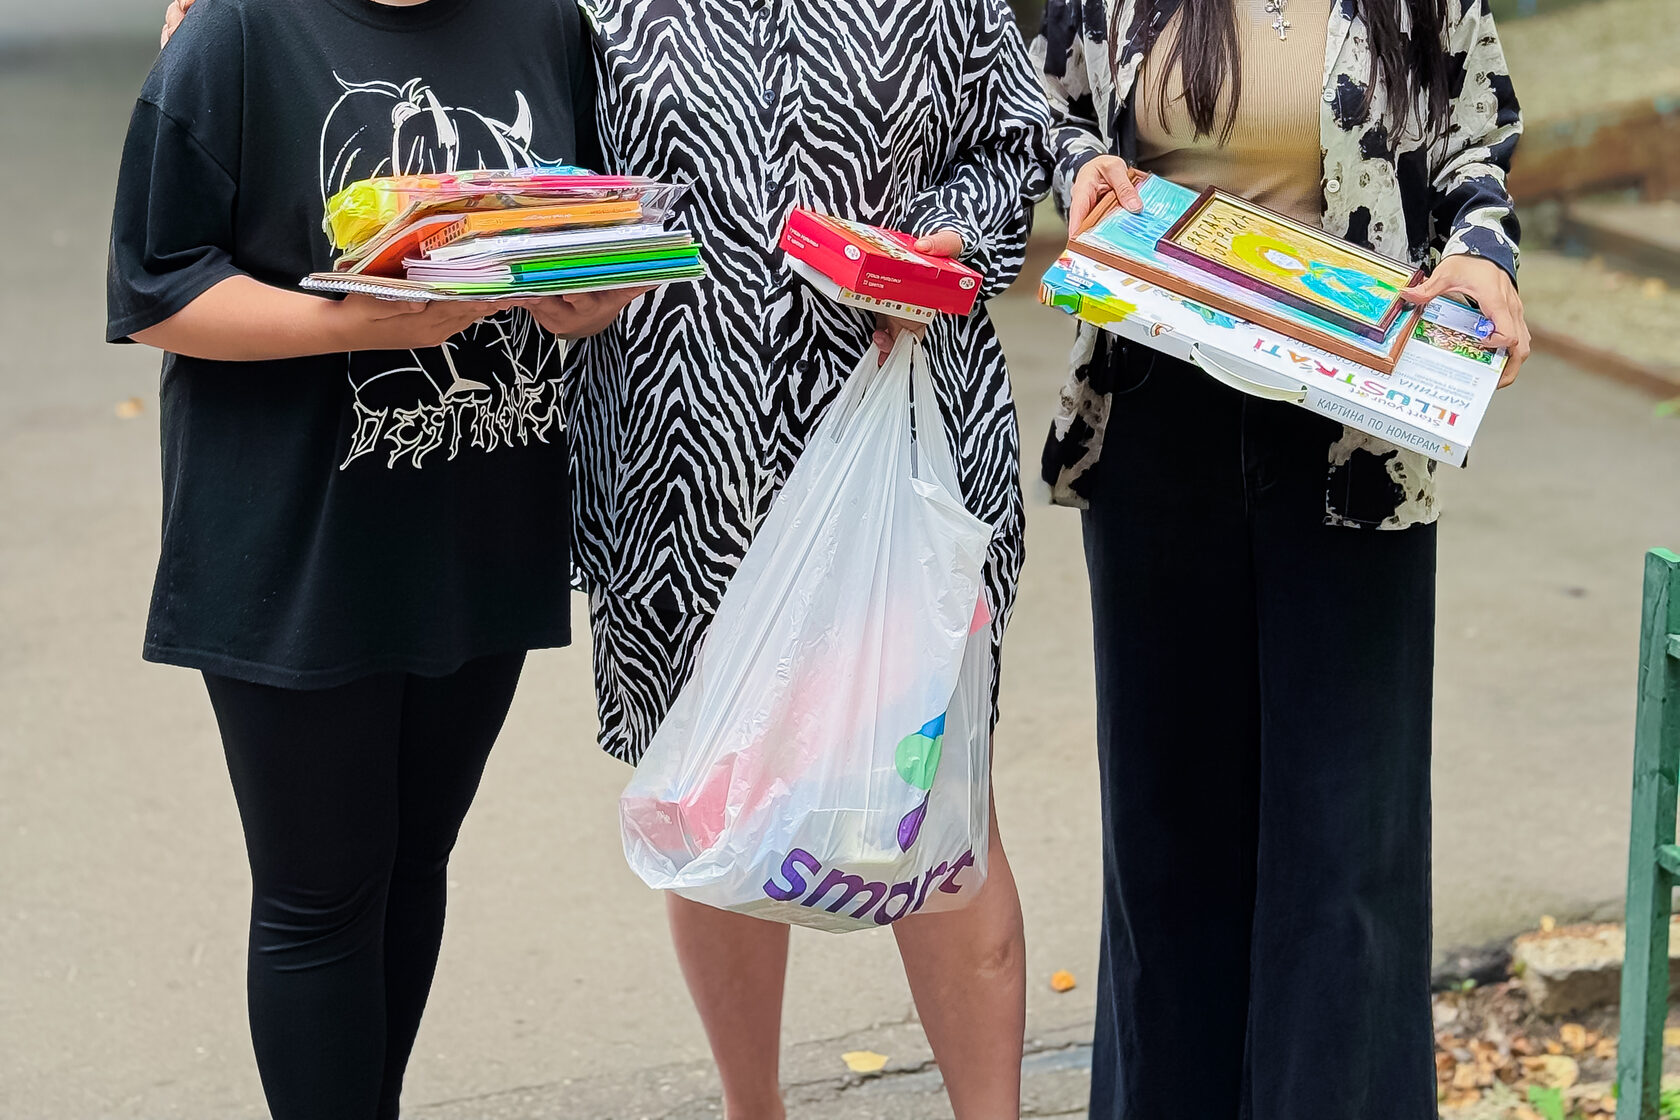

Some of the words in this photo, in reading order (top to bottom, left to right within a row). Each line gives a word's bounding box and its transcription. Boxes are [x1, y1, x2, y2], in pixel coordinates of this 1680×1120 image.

[1370, 396, 1404, 413] your
[1316, 396, 1364, 425] КАРТИНА
[1367, 417, 1384, 431] ПО
[1385, 424, 1441, 454] НОМЕРАМ
[1406, 410, 1441, 427] Start
